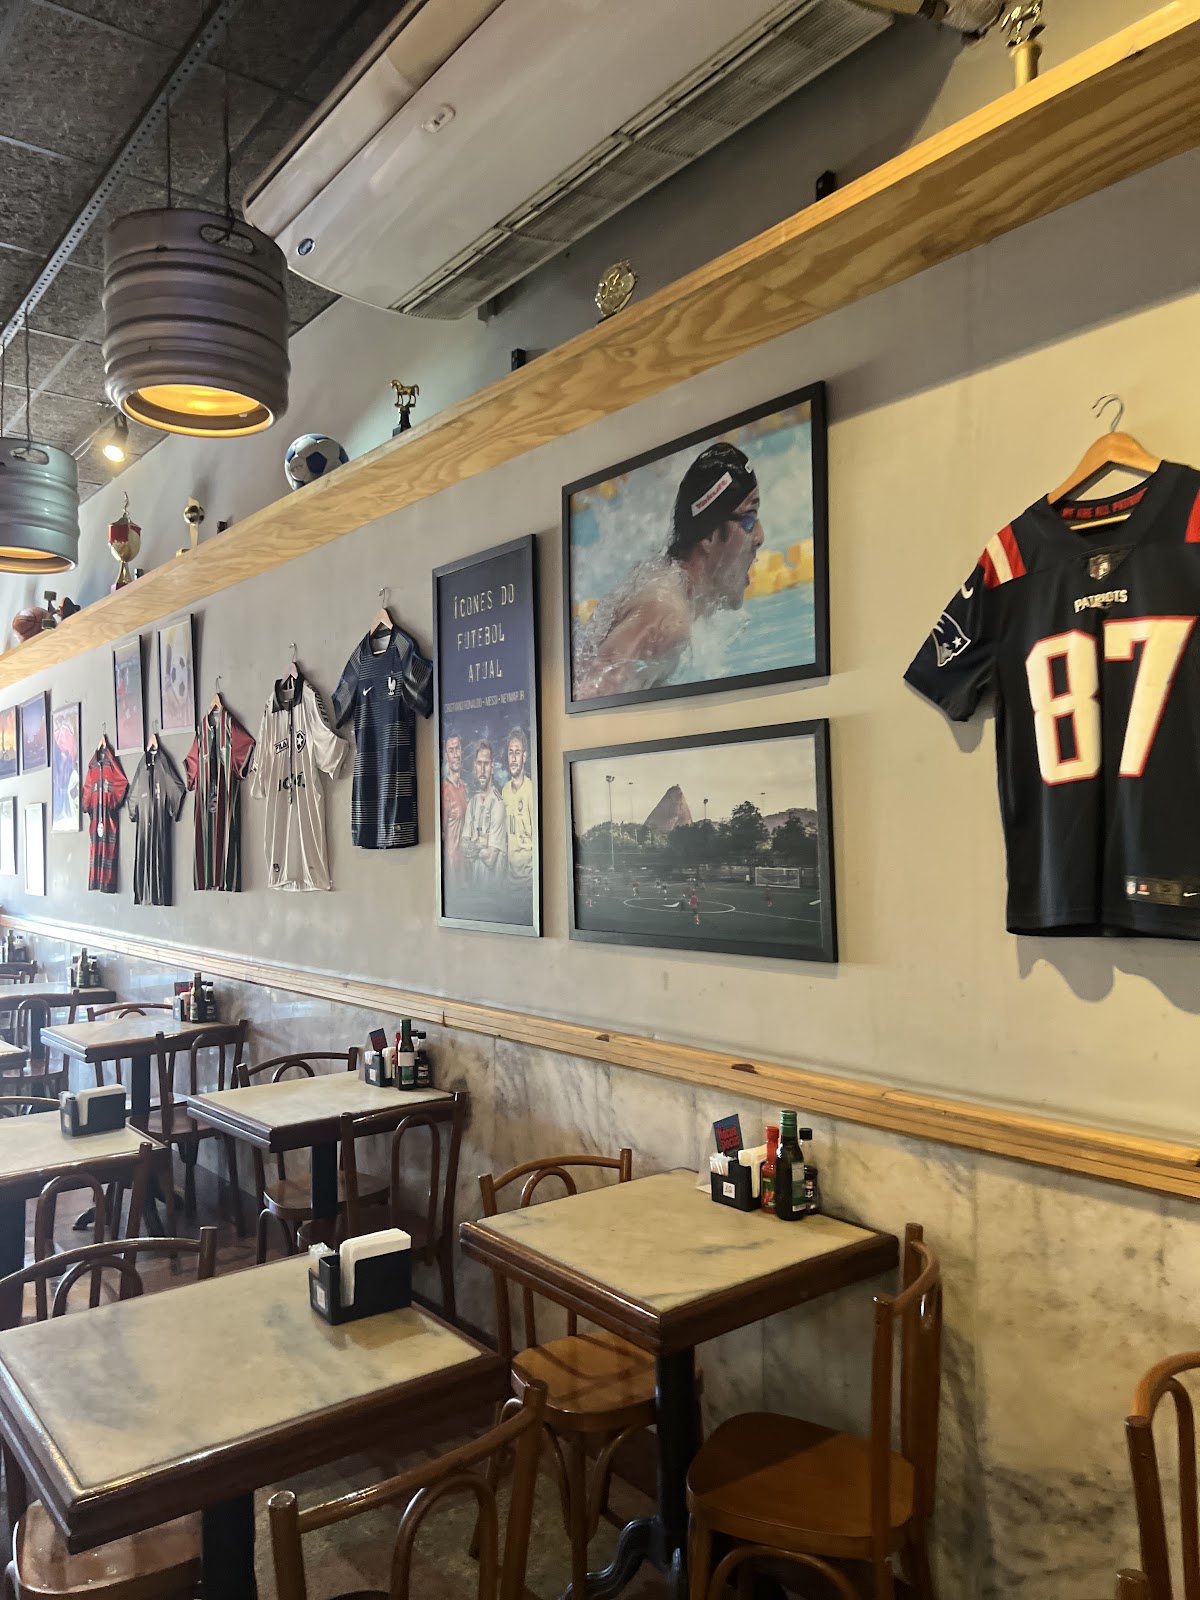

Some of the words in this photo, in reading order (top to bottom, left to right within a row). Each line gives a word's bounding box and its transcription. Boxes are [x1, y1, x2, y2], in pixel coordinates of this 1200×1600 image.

[454, 590, 493, 619] ÍCONES
[501, 583, 514, 606] DO
[1074, 589, 1128, 614] PATRIOTS
[457, 623, 504, 651] FUTEBOL
[468, 659, 502, 682] ATUAL
[1025, 615, 1197, 786] 87
